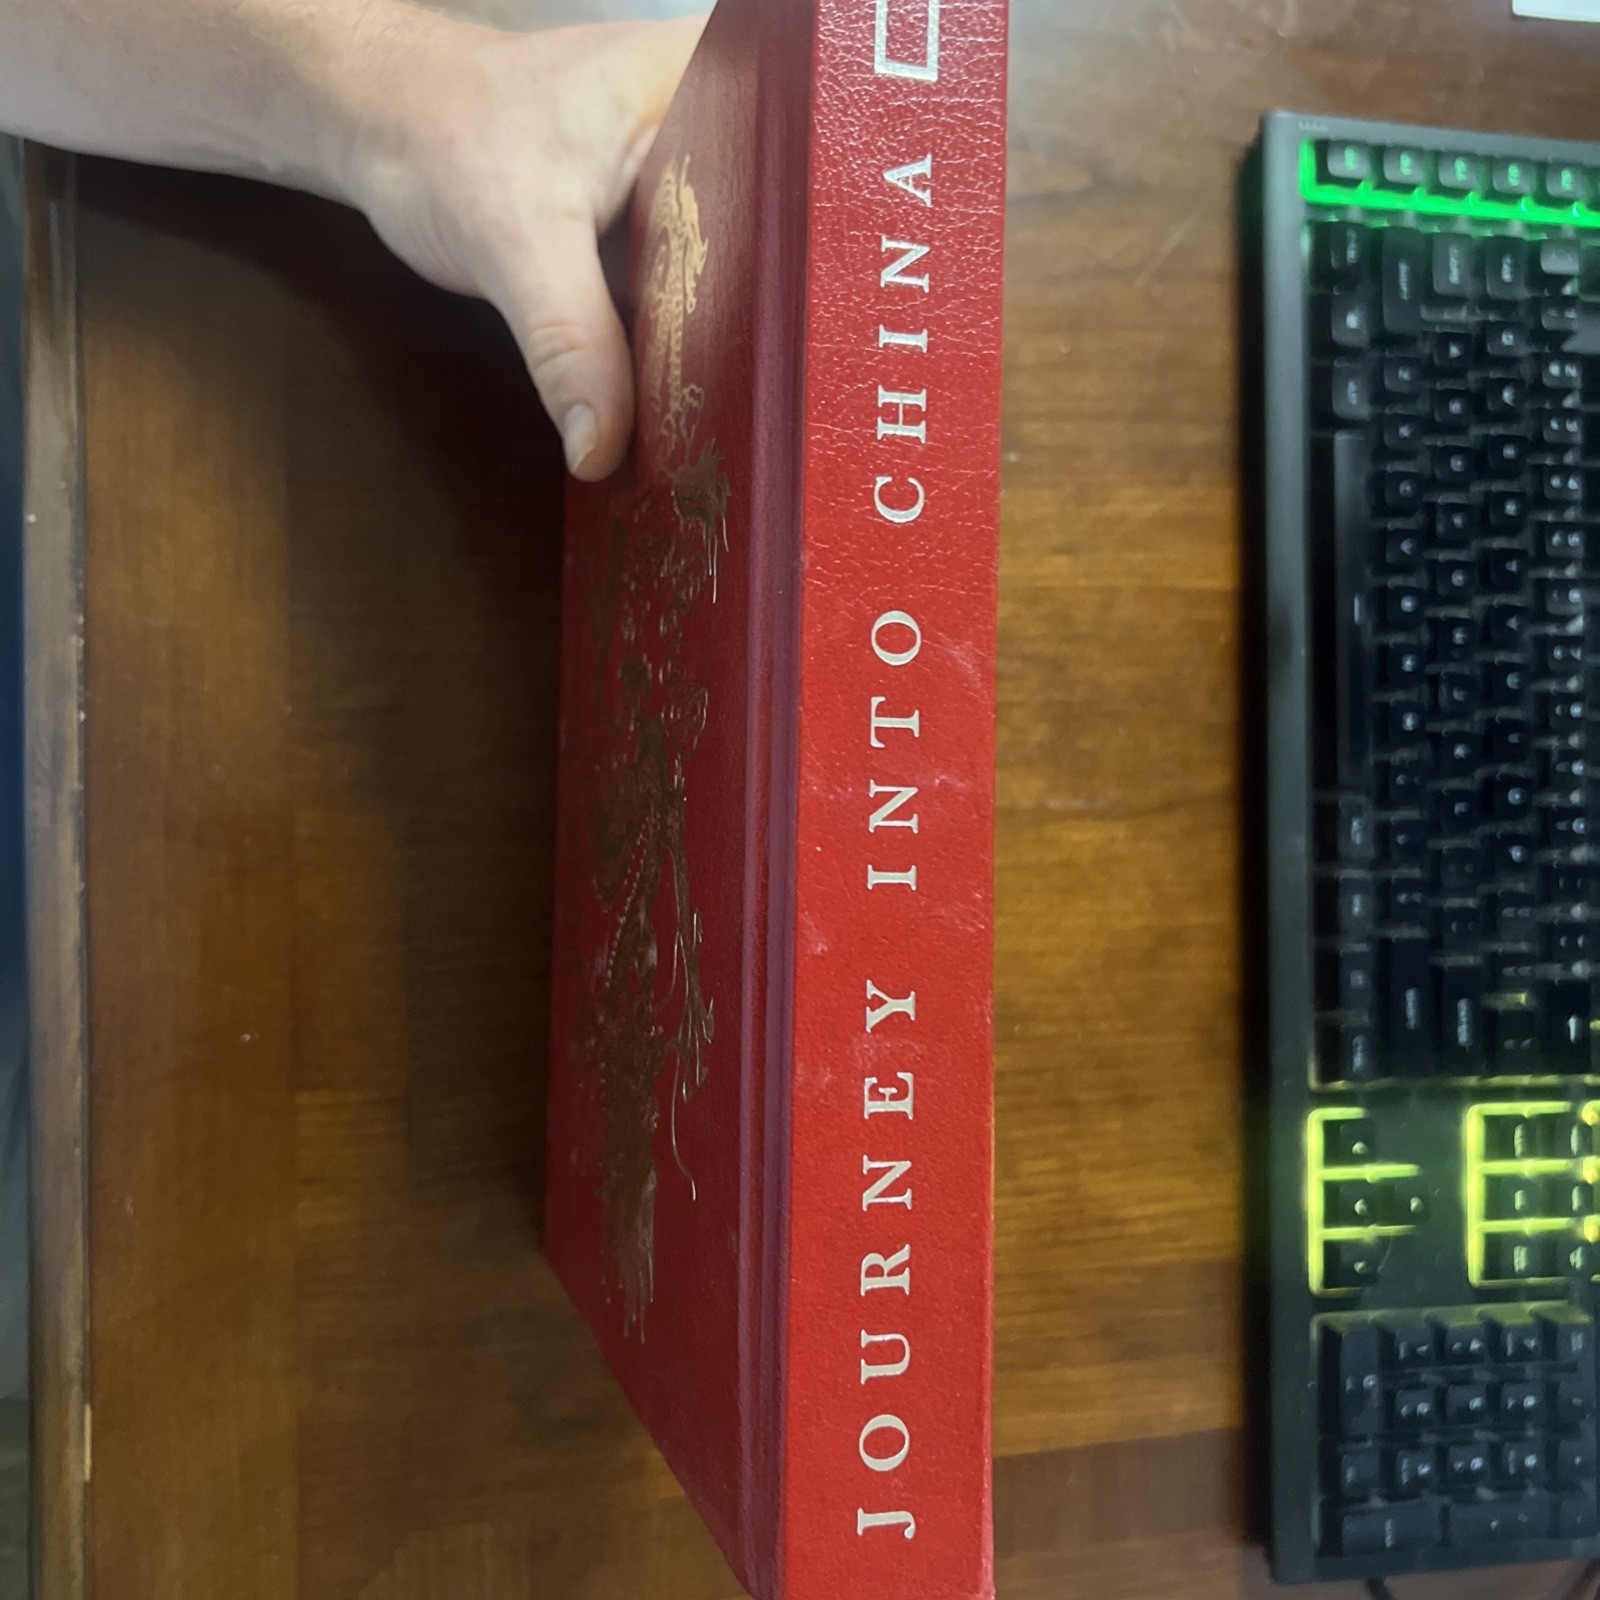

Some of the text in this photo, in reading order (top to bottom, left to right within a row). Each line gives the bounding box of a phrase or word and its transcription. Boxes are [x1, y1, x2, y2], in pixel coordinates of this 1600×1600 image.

[857, 152, 934, 1540] JOURNEY INTO CHINA
